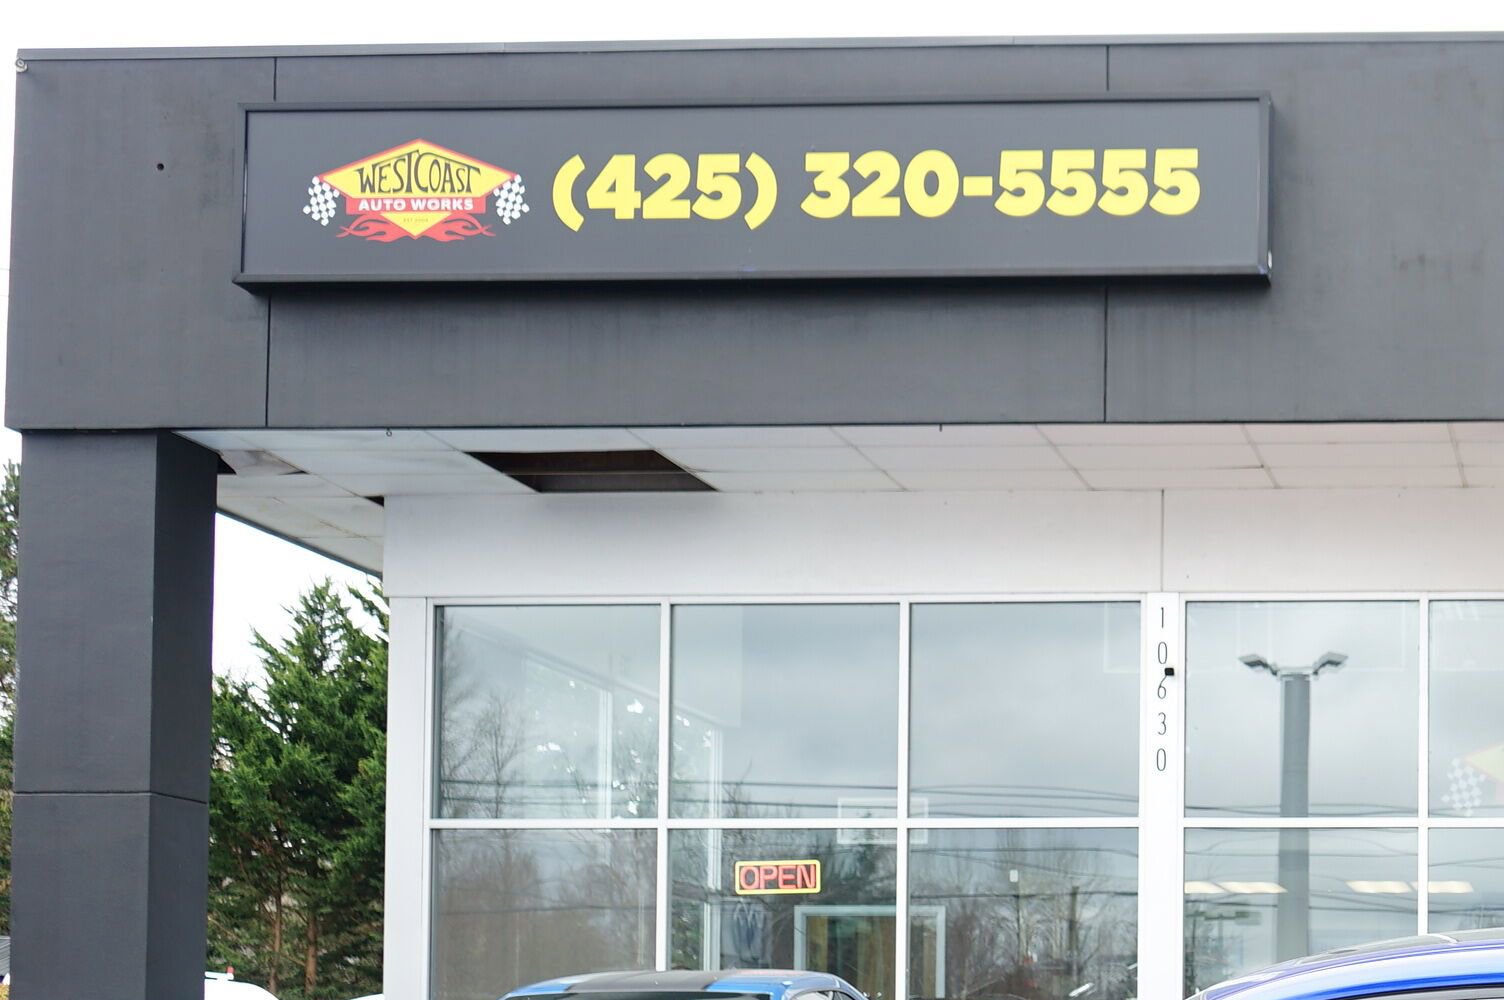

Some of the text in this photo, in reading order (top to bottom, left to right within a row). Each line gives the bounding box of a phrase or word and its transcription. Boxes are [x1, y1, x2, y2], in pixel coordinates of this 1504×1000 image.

[552, 148, 1201, 231] (425) 320-5555
[358, 198, 474, 211] AUTO WORKS
[740, 864, 816, 890] OPEN
